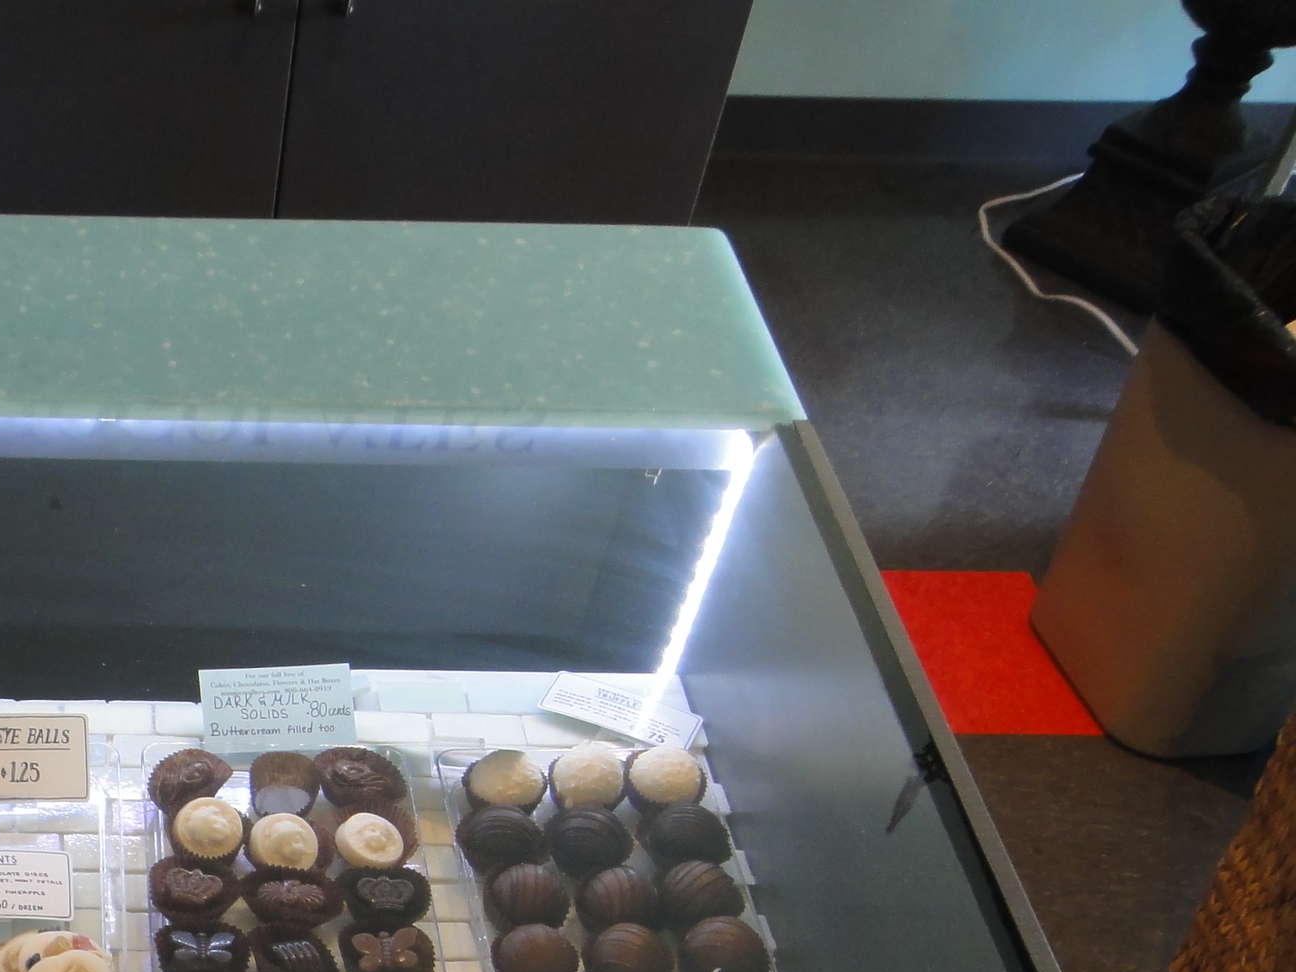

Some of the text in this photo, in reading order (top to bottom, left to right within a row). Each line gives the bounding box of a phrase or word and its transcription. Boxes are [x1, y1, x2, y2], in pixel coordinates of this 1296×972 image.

[213, 692, 253, 710] DARK
[240, 708, 289, 720] SOLIDS
[27, 728, 70, 744] BALLS
[210, 721, 335, 737] Buttercream filled too
